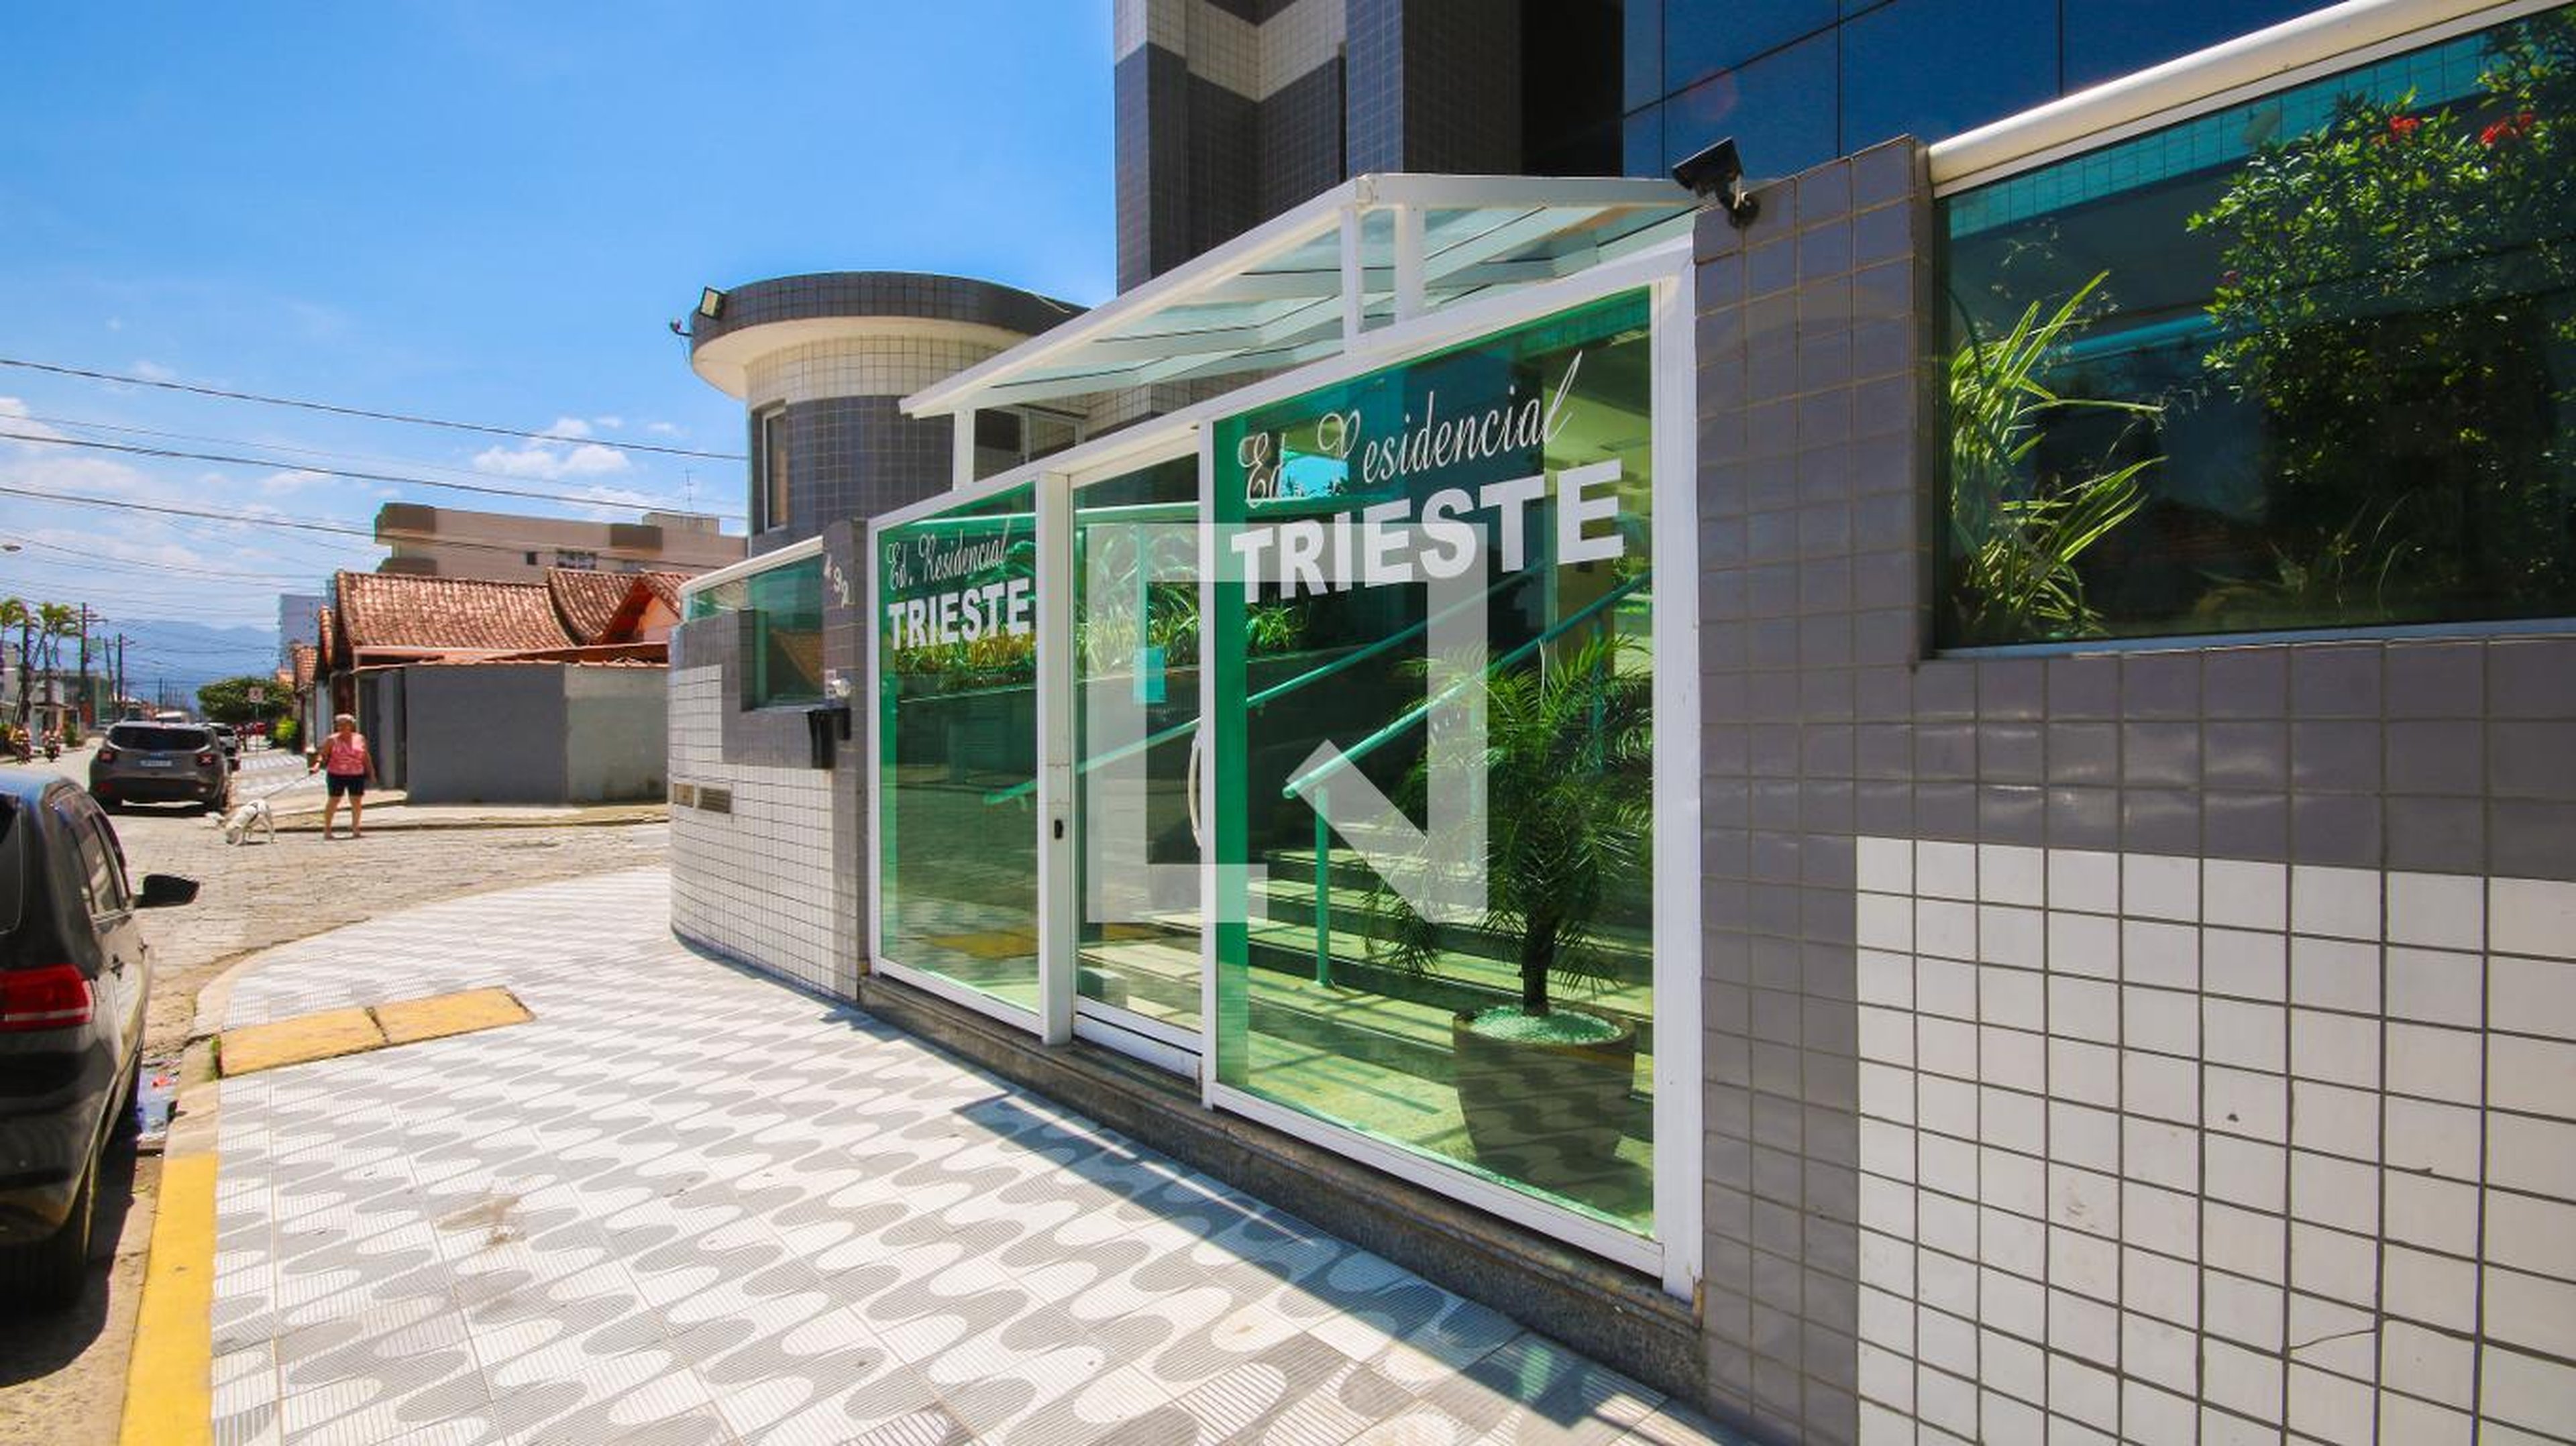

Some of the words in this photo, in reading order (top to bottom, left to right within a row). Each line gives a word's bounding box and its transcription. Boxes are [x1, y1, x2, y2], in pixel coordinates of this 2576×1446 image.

[918, 516, 1010, 583] Residencial
[1231, 458, 1624, 604] TRIESTE
[888, 577, 1030, 651] TRIESTE
